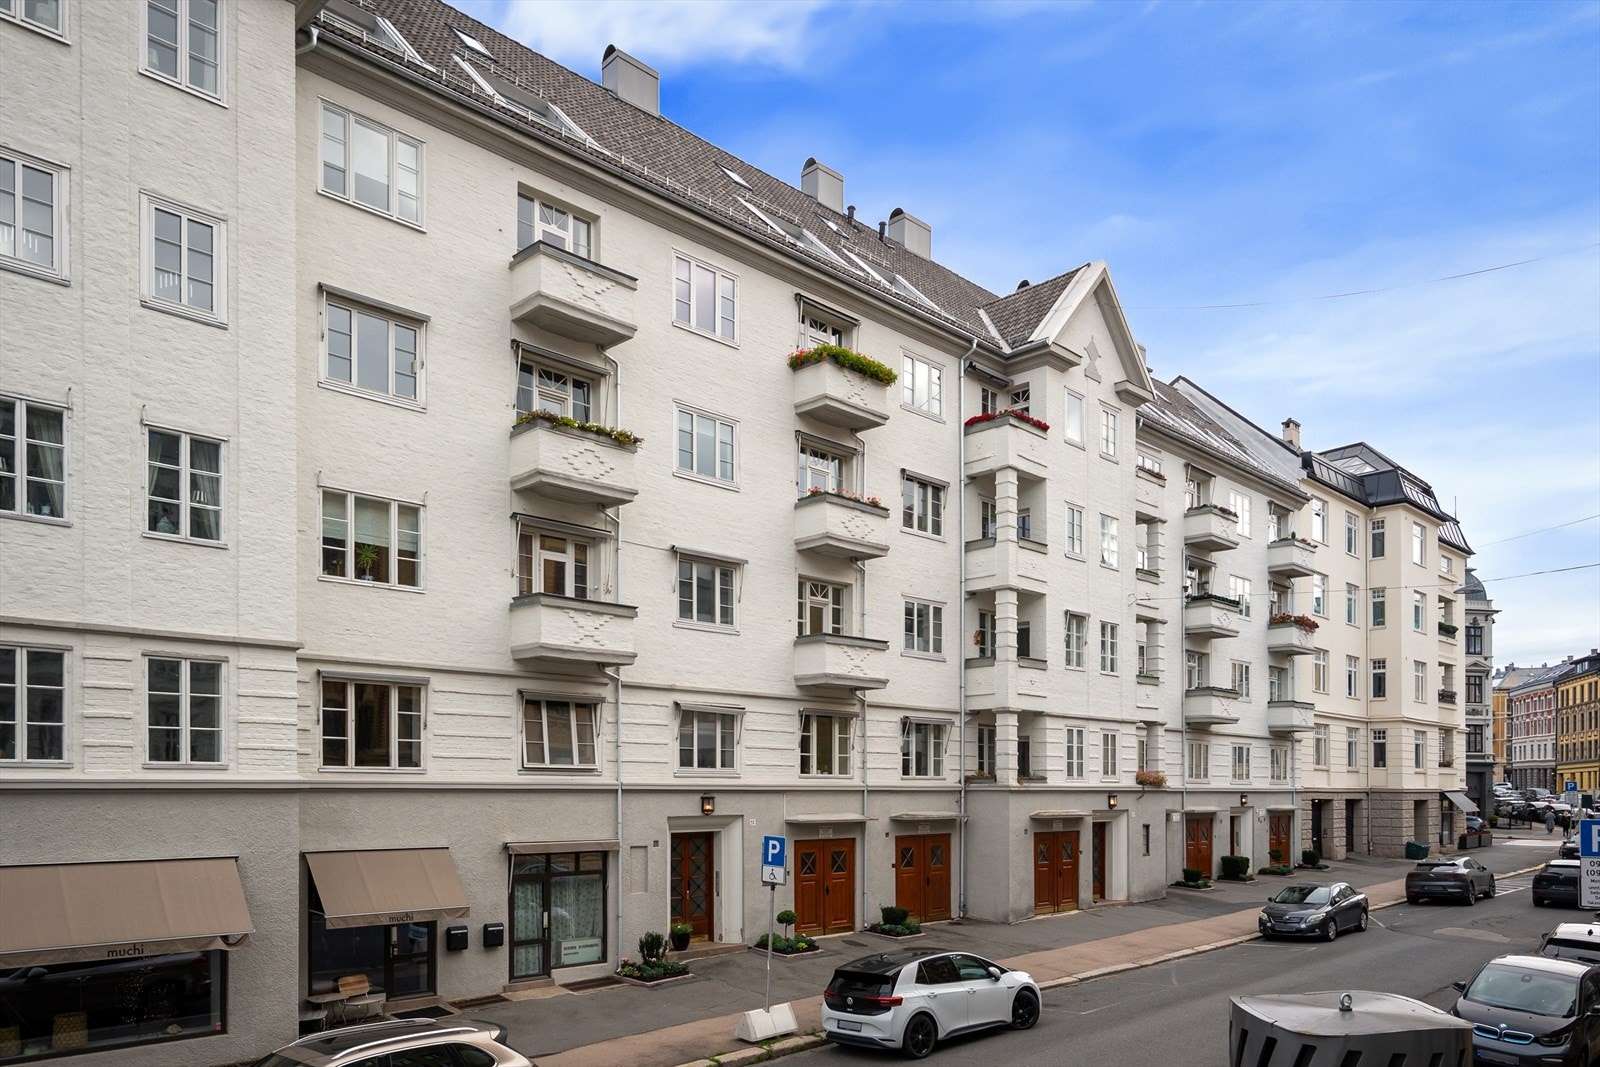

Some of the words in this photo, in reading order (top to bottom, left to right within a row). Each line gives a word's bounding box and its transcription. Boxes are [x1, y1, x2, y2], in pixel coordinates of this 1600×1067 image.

[1567, 782, 1575, 790] P
[768, 840, 780, 862] P
[389, 912, 414, 923] muchi
[107, 944, 144, 957] muchi
